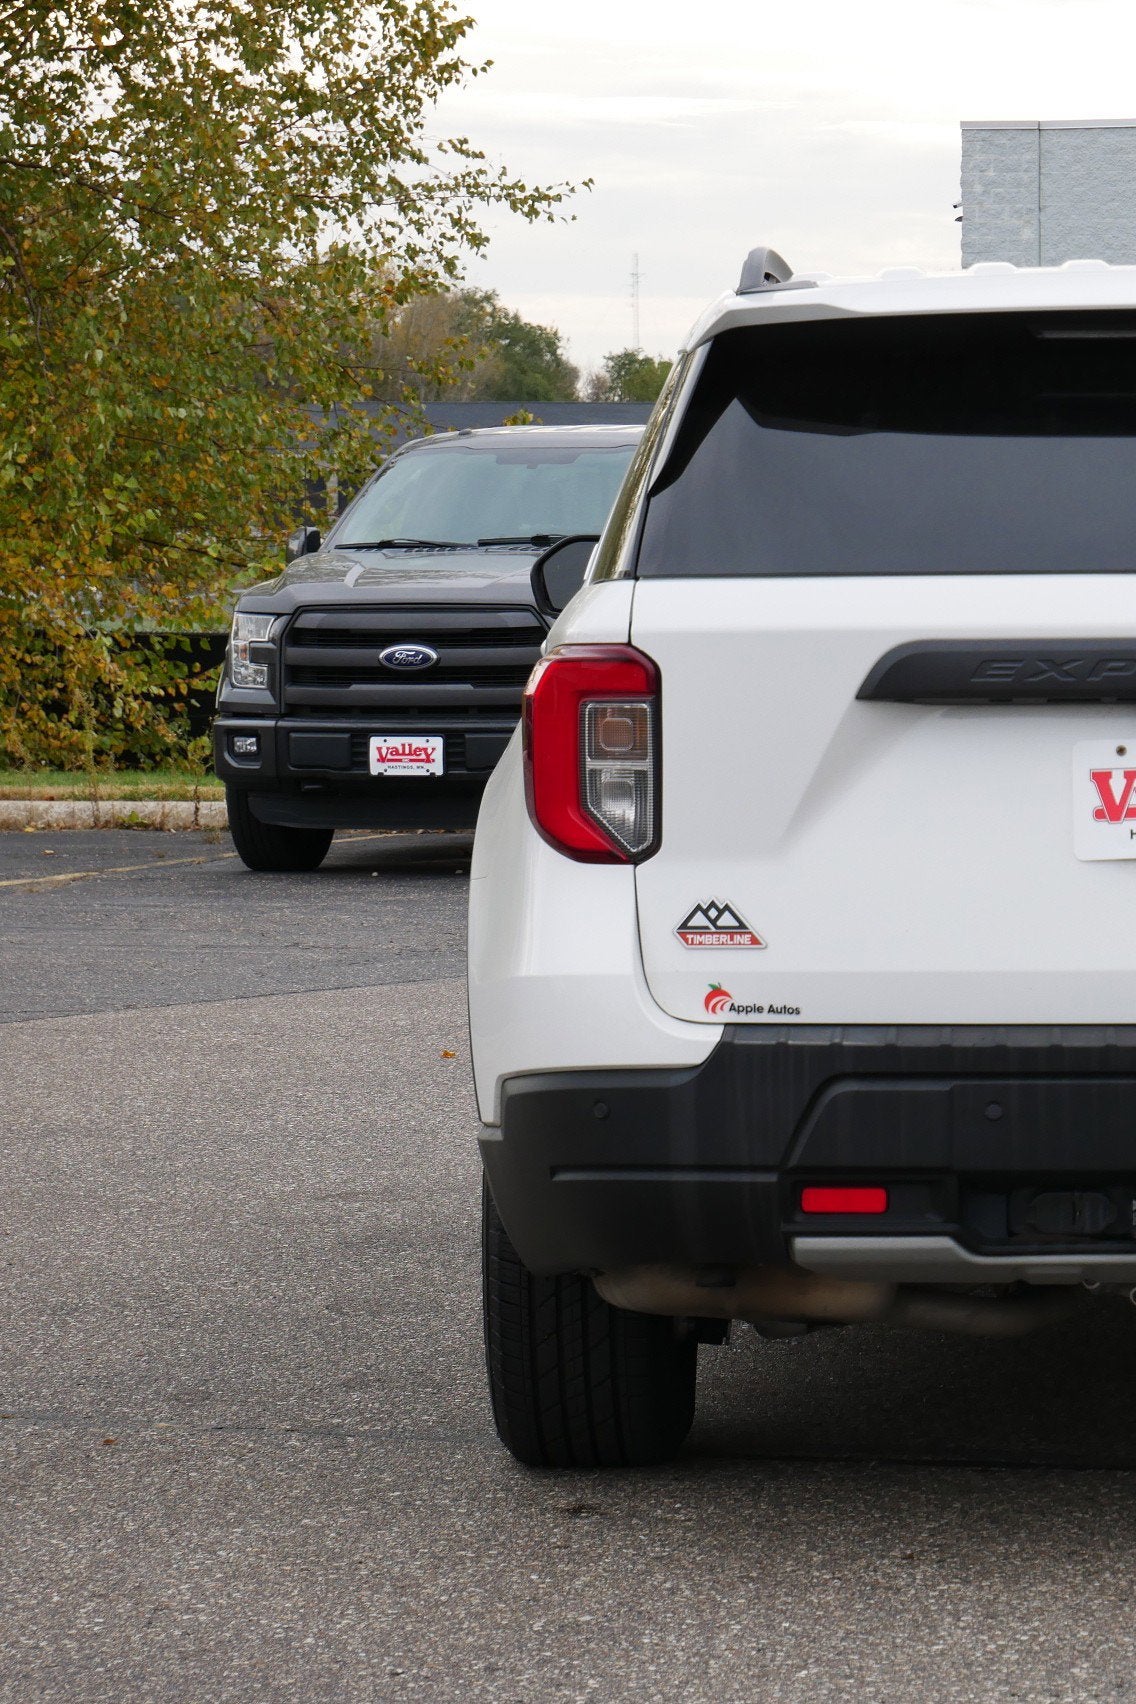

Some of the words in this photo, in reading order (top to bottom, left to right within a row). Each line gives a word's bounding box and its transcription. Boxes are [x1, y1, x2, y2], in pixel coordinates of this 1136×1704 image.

[392, 650, 423, 665] Ford
[686, 934, 752, 945] TIMBERLINE
[728, 1002, 765, 1015] Apple
[767, 1004, 801, 1015] Autos
